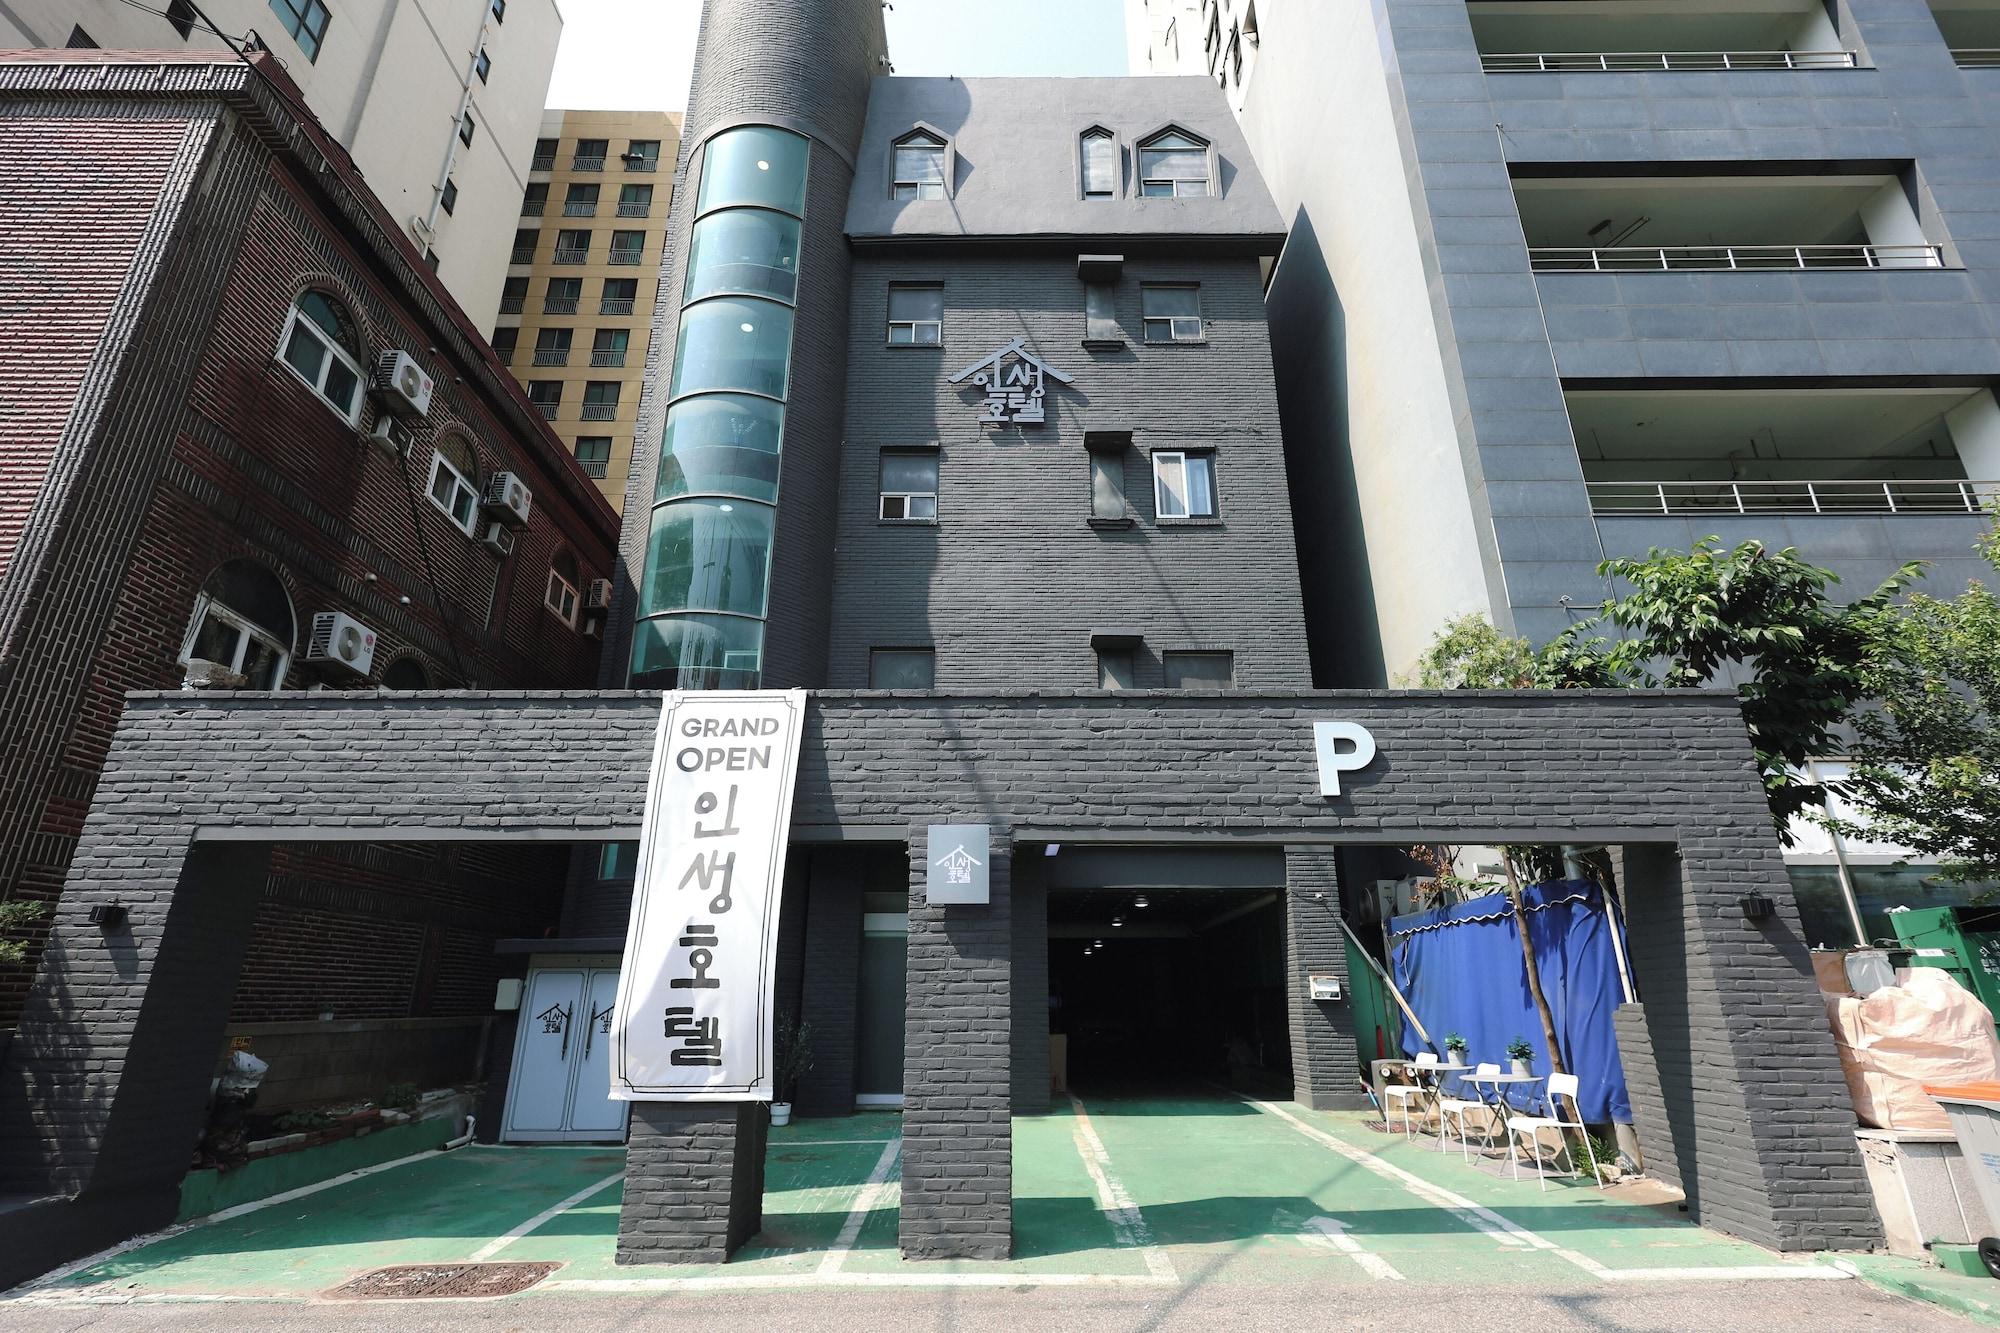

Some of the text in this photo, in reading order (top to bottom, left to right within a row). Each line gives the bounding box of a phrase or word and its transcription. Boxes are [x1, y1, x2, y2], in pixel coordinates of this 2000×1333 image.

[973, 360, 1046, 398] 인생
[979, 392, 1045, 422] 호텔
[681, 718, 779, 738] GRAND
[676, 745, 771, 773] OPEN
[1313, 722, 1376, 796] P
[943, 854, 971, 873] 인생
